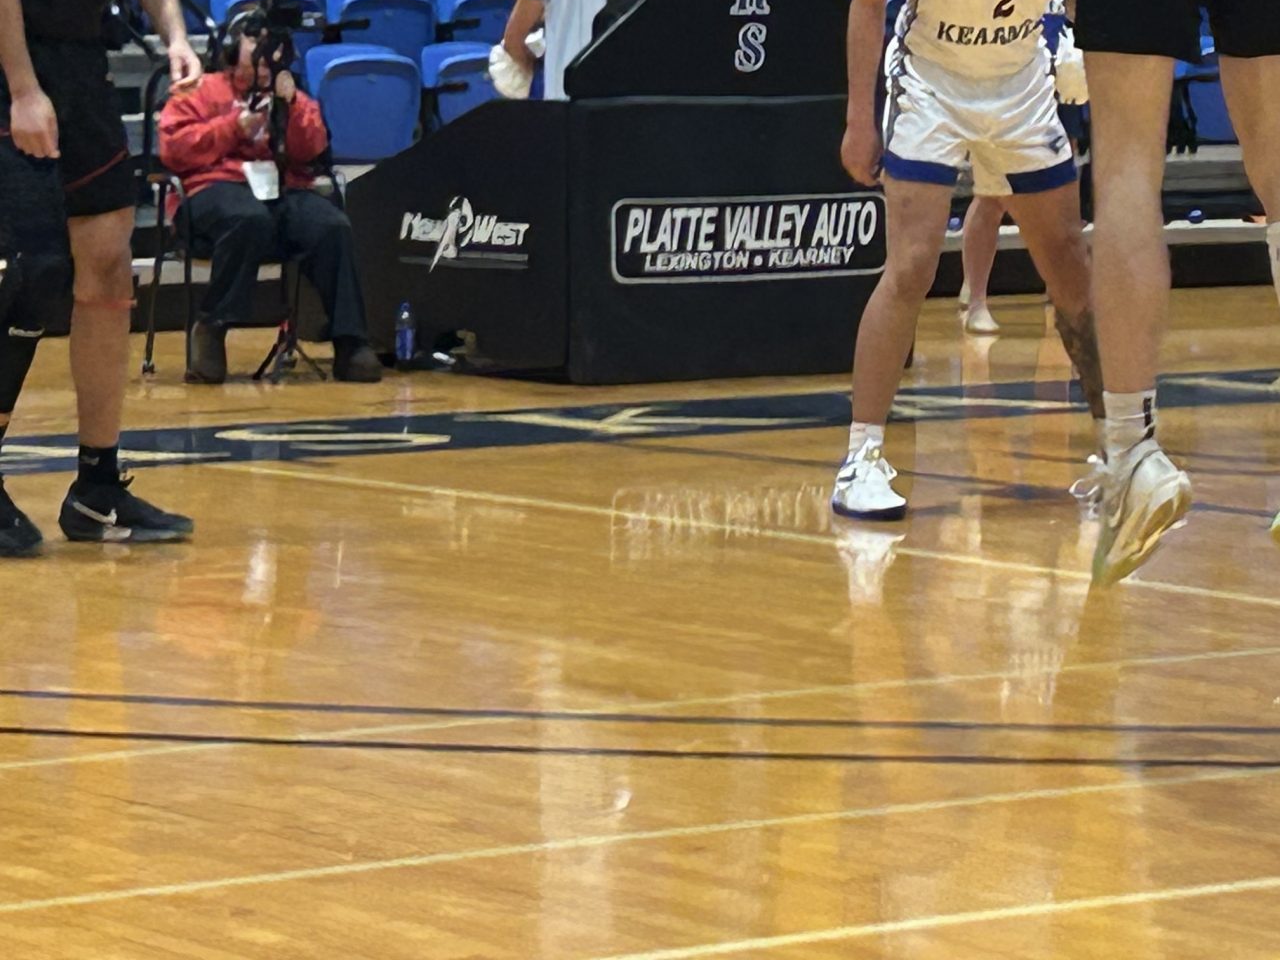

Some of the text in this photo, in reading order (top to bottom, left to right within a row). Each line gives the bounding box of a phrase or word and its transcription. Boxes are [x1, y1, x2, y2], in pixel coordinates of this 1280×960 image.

[624, 200, 878, 253] PLATTE VALLEY AUTO
[644, 246, 854, 271] LEXINGTON KEARNEY
